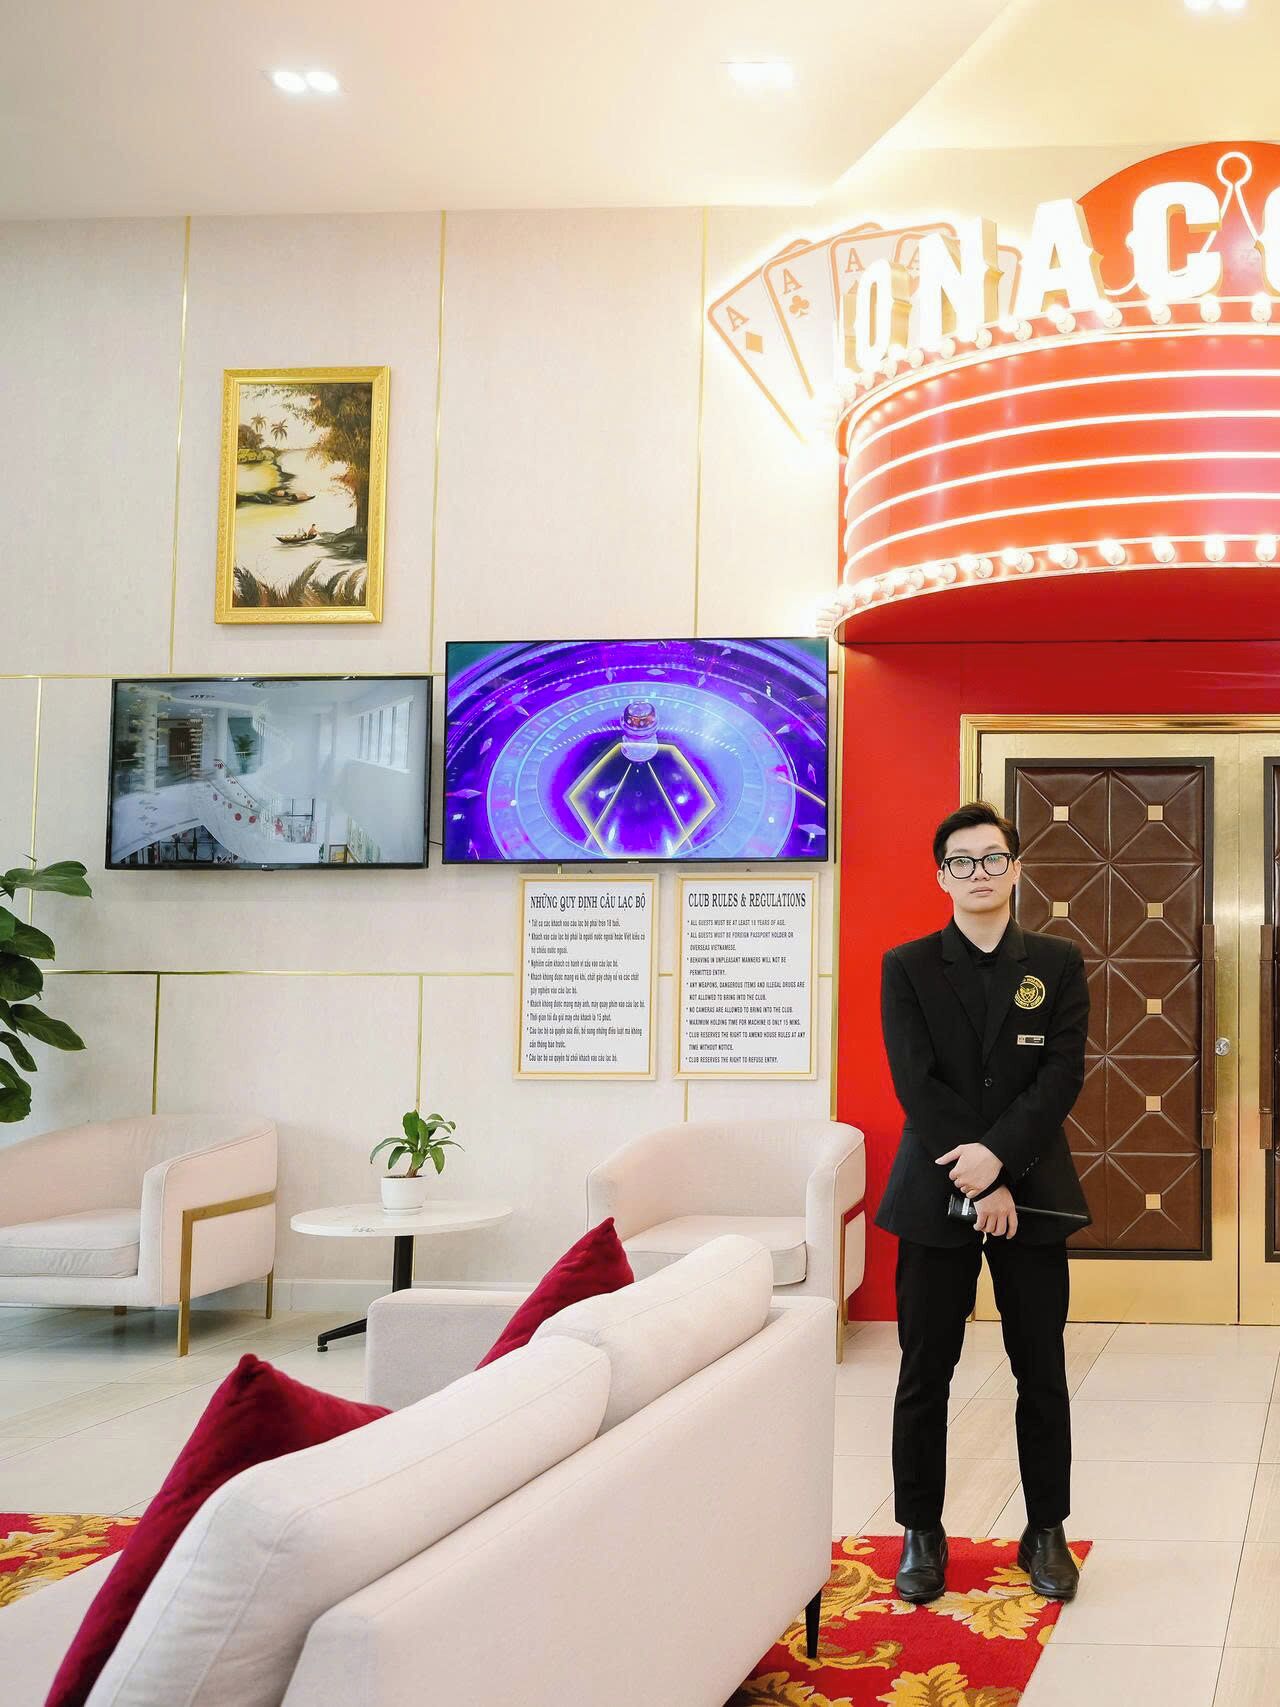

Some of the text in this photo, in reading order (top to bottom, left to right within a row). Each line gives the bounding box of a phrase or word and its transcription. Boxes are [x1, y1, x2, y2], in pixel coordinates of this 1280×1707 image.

[845, 248, 865, 273] A
[783, 268, 802, 294] A
[726, 306, 749, 332] A
[560, 896, 576, 912] QUY
[600, 893, 615, 909] CÂU
[689, 893, 806, 907] CLUB RULES & REGULATIONS
